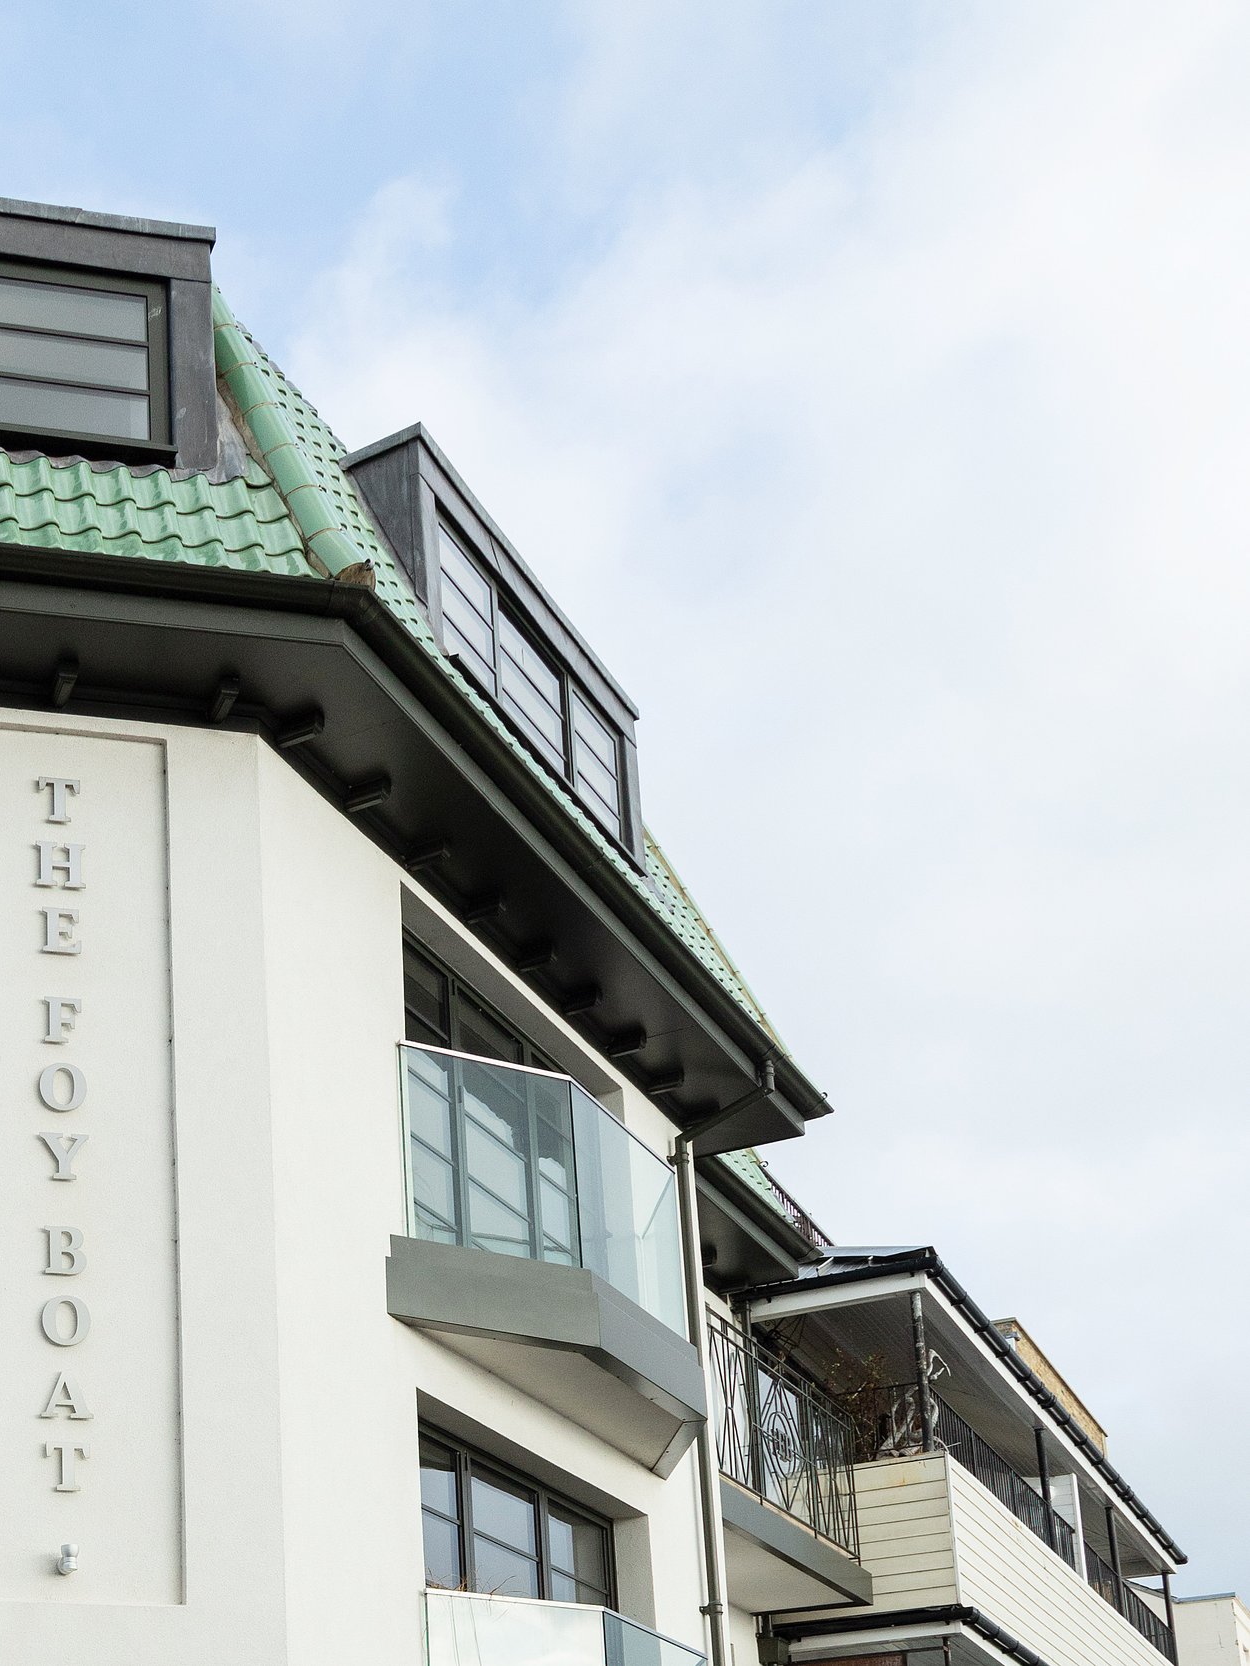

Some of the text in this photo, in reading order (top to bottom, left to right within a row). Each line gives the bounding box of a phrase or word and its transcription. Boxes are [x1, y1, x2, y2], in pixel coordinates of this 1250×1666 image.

[34, 775, 94, 1492] THE FOY BOAT
